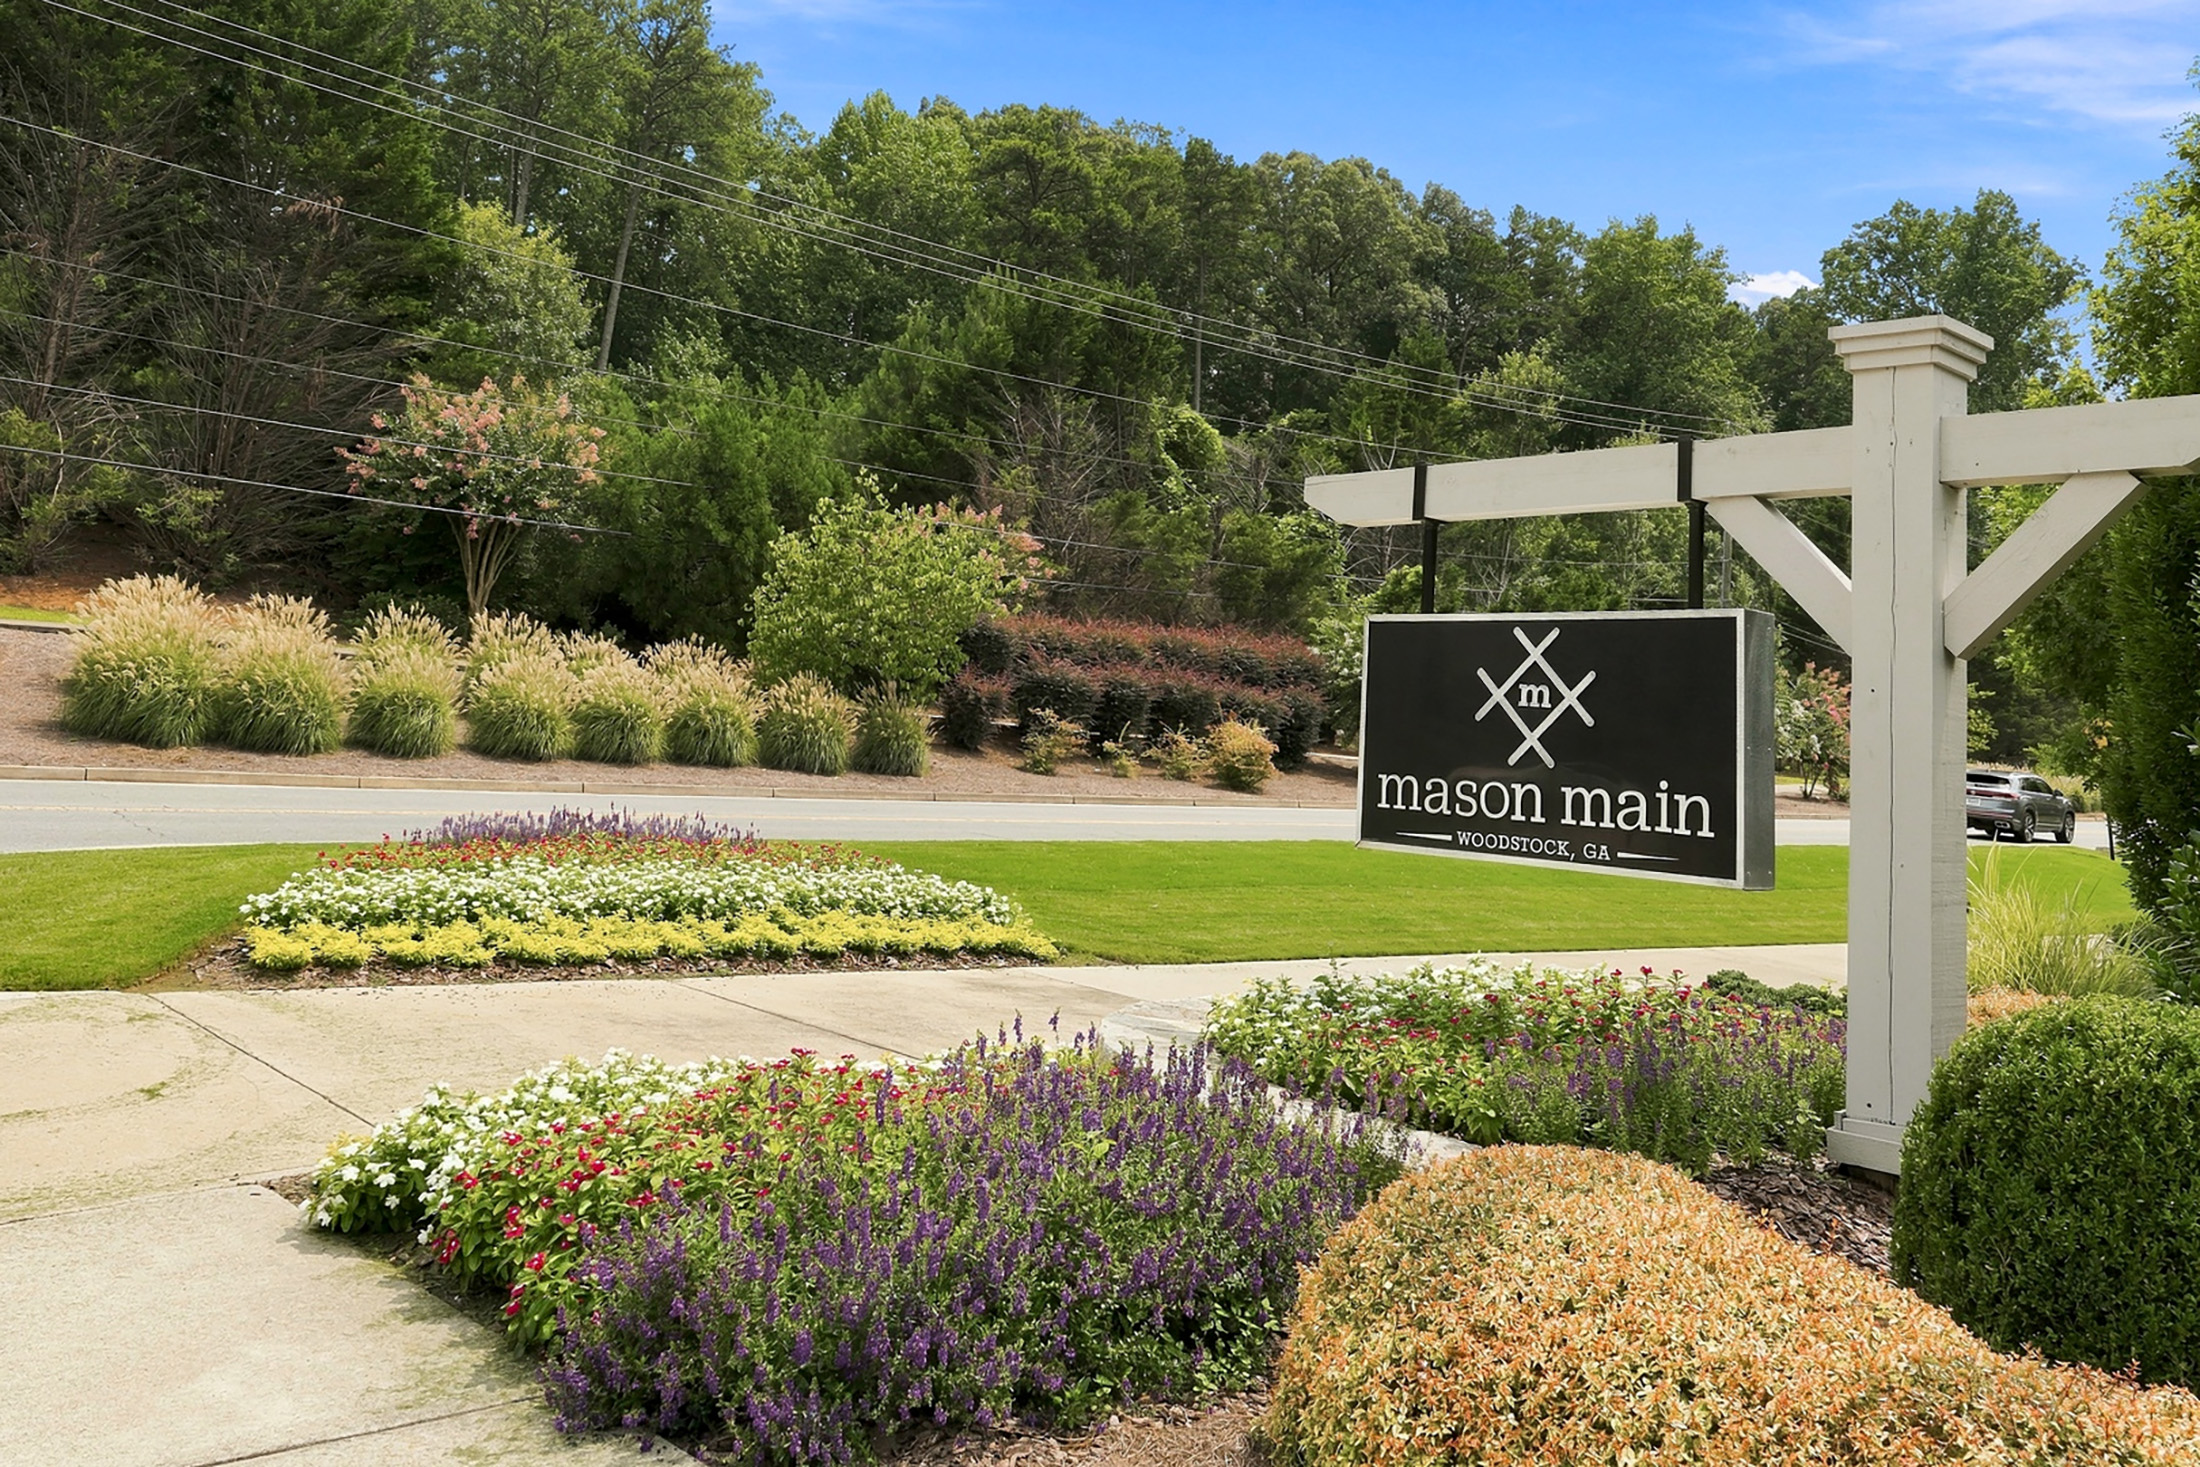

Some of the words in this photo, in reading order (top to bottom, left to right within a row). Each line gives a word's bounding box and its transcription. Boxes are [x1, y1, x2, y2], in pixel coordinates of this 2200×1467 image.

[1517, 682, 1552, 709] m
[1376, 773, 1546, 824] mason
[1560, 780, 1715, 839] main
[1456, 830, 1576, 862] WOODSTOCK,
[1582, 842, 1611, 861] GA
